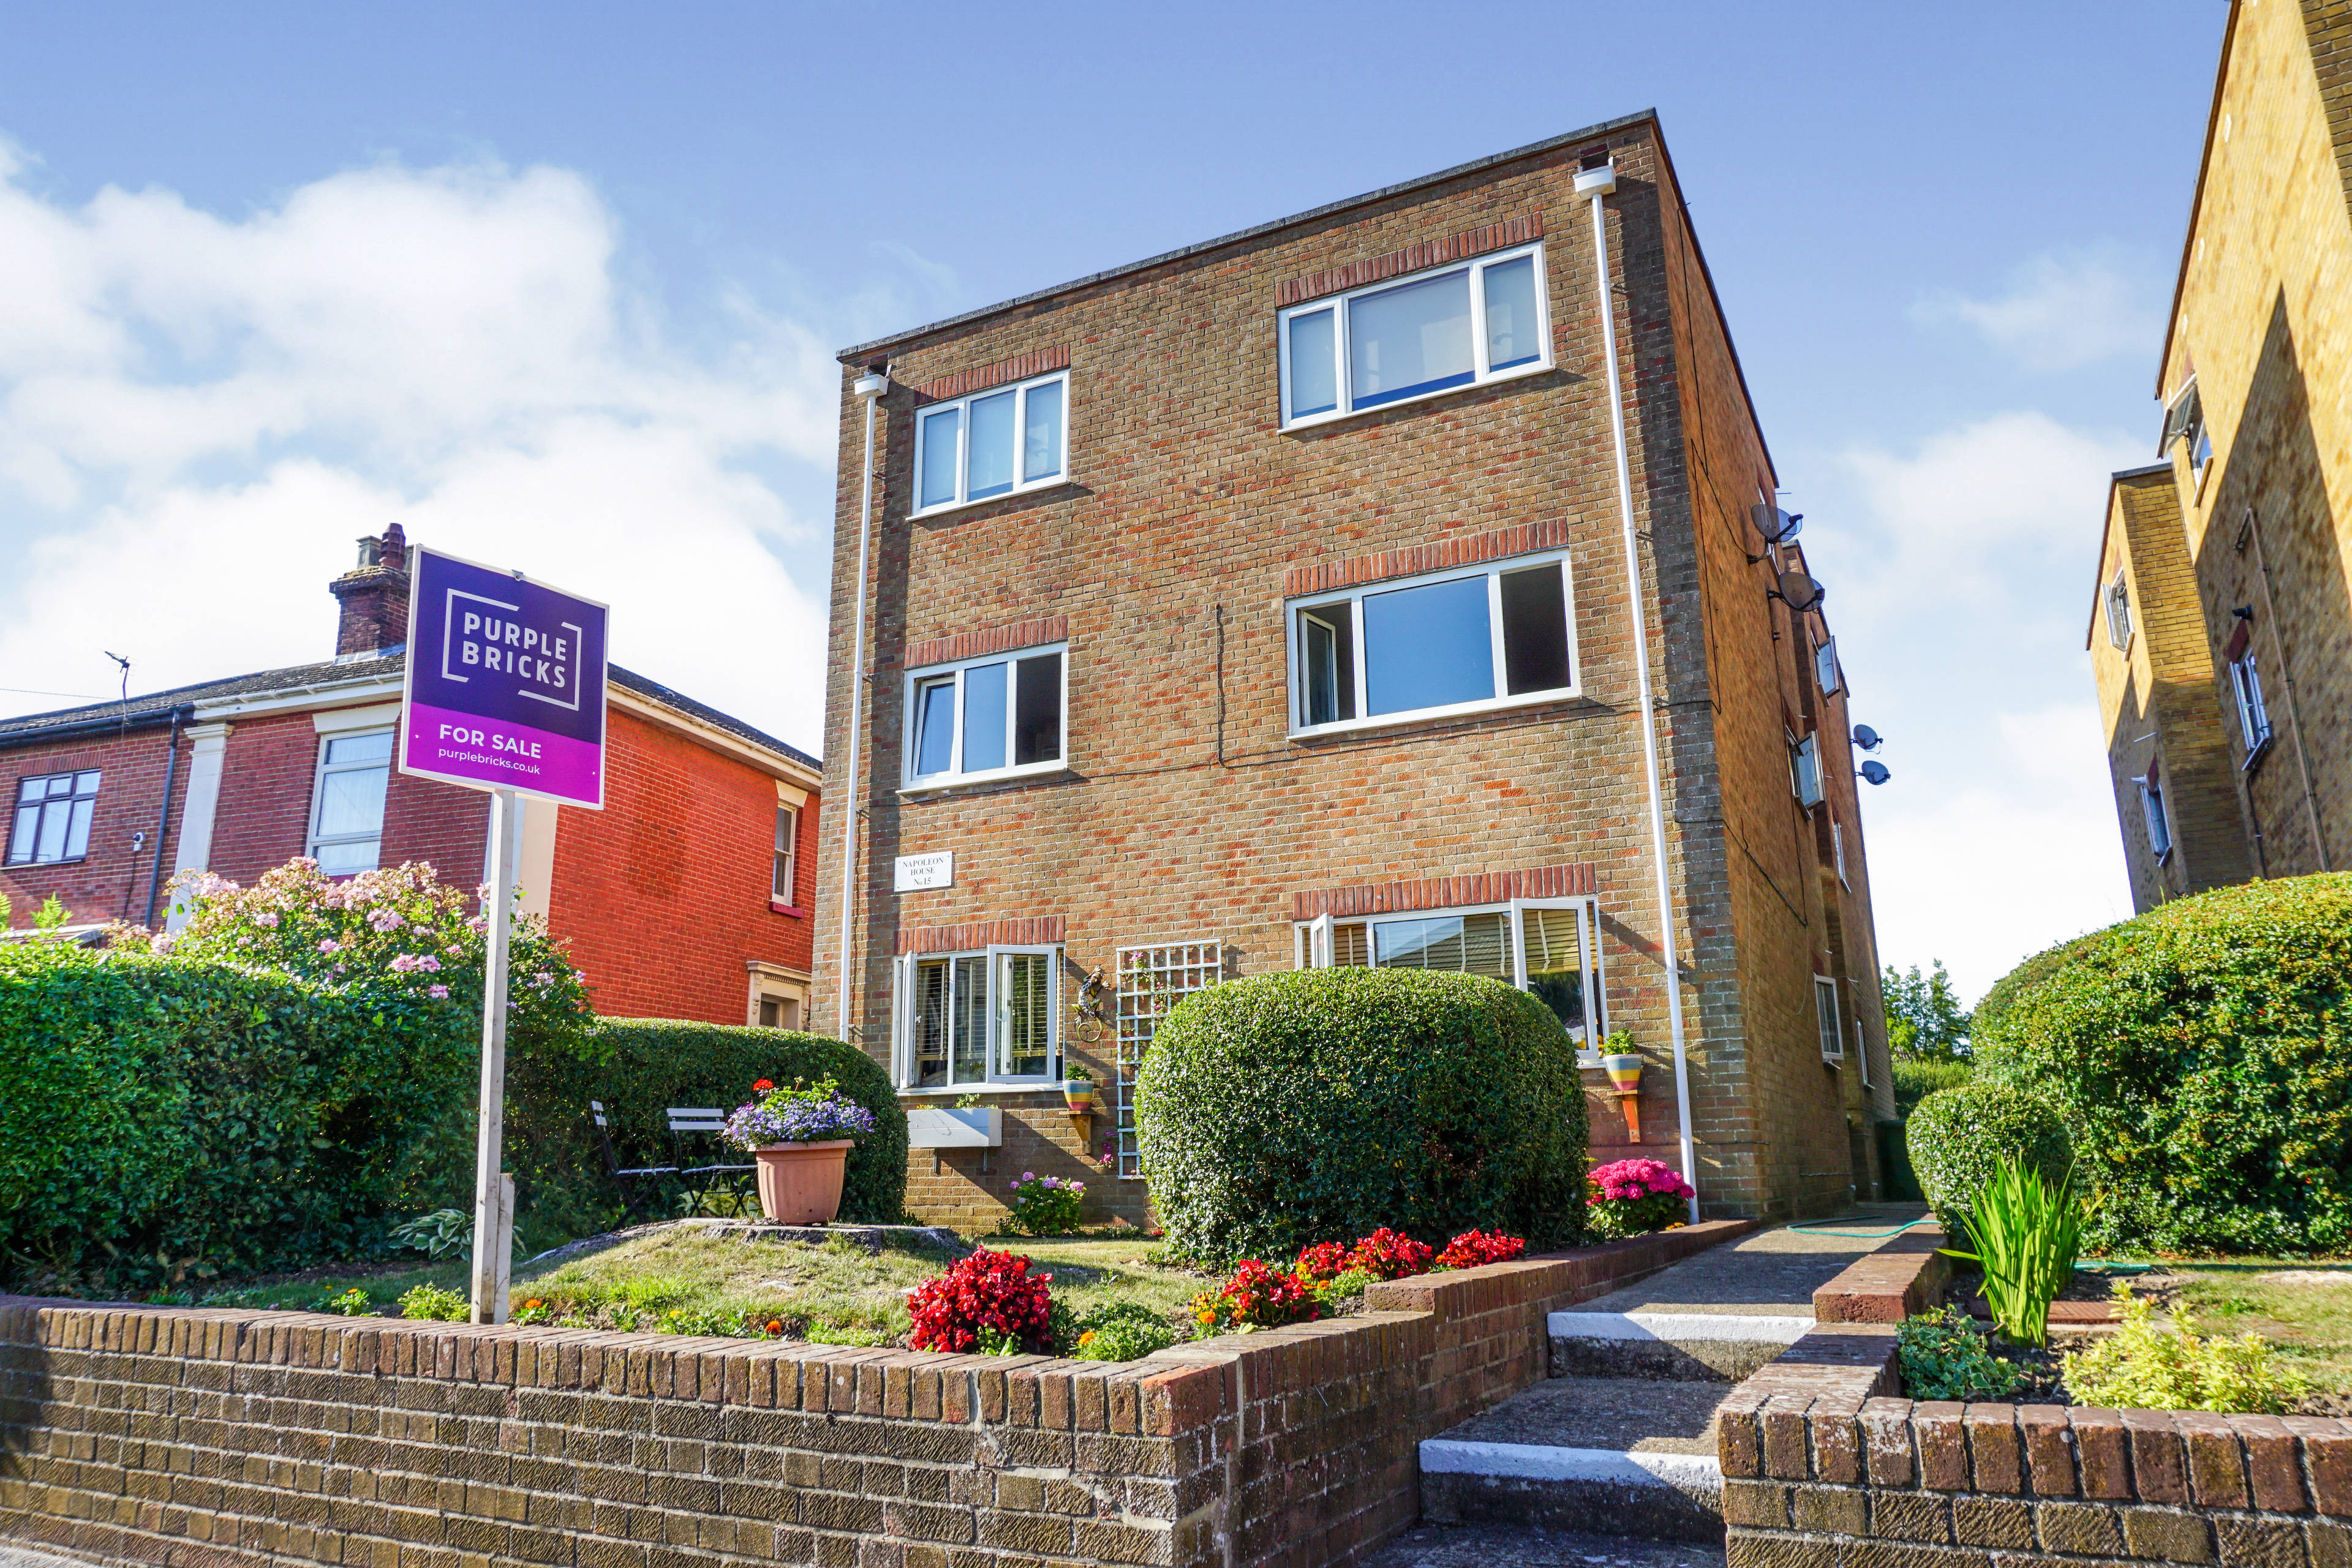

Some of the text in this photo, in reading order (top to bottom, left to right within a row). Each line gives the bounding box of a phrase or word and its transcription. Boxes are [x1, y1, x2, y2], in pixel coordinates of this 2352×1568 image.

[464, 612, 567, 662] PURPLE
[462, 641, 565, 688] BRICKS
[439, 724, 541, 759] FOR SALE
[439, 747, 540, 775] purplebricks.co.uk
[903, 857, 944, 868] NAPOLEON
[911, 867, 935, 876] HOUSE
